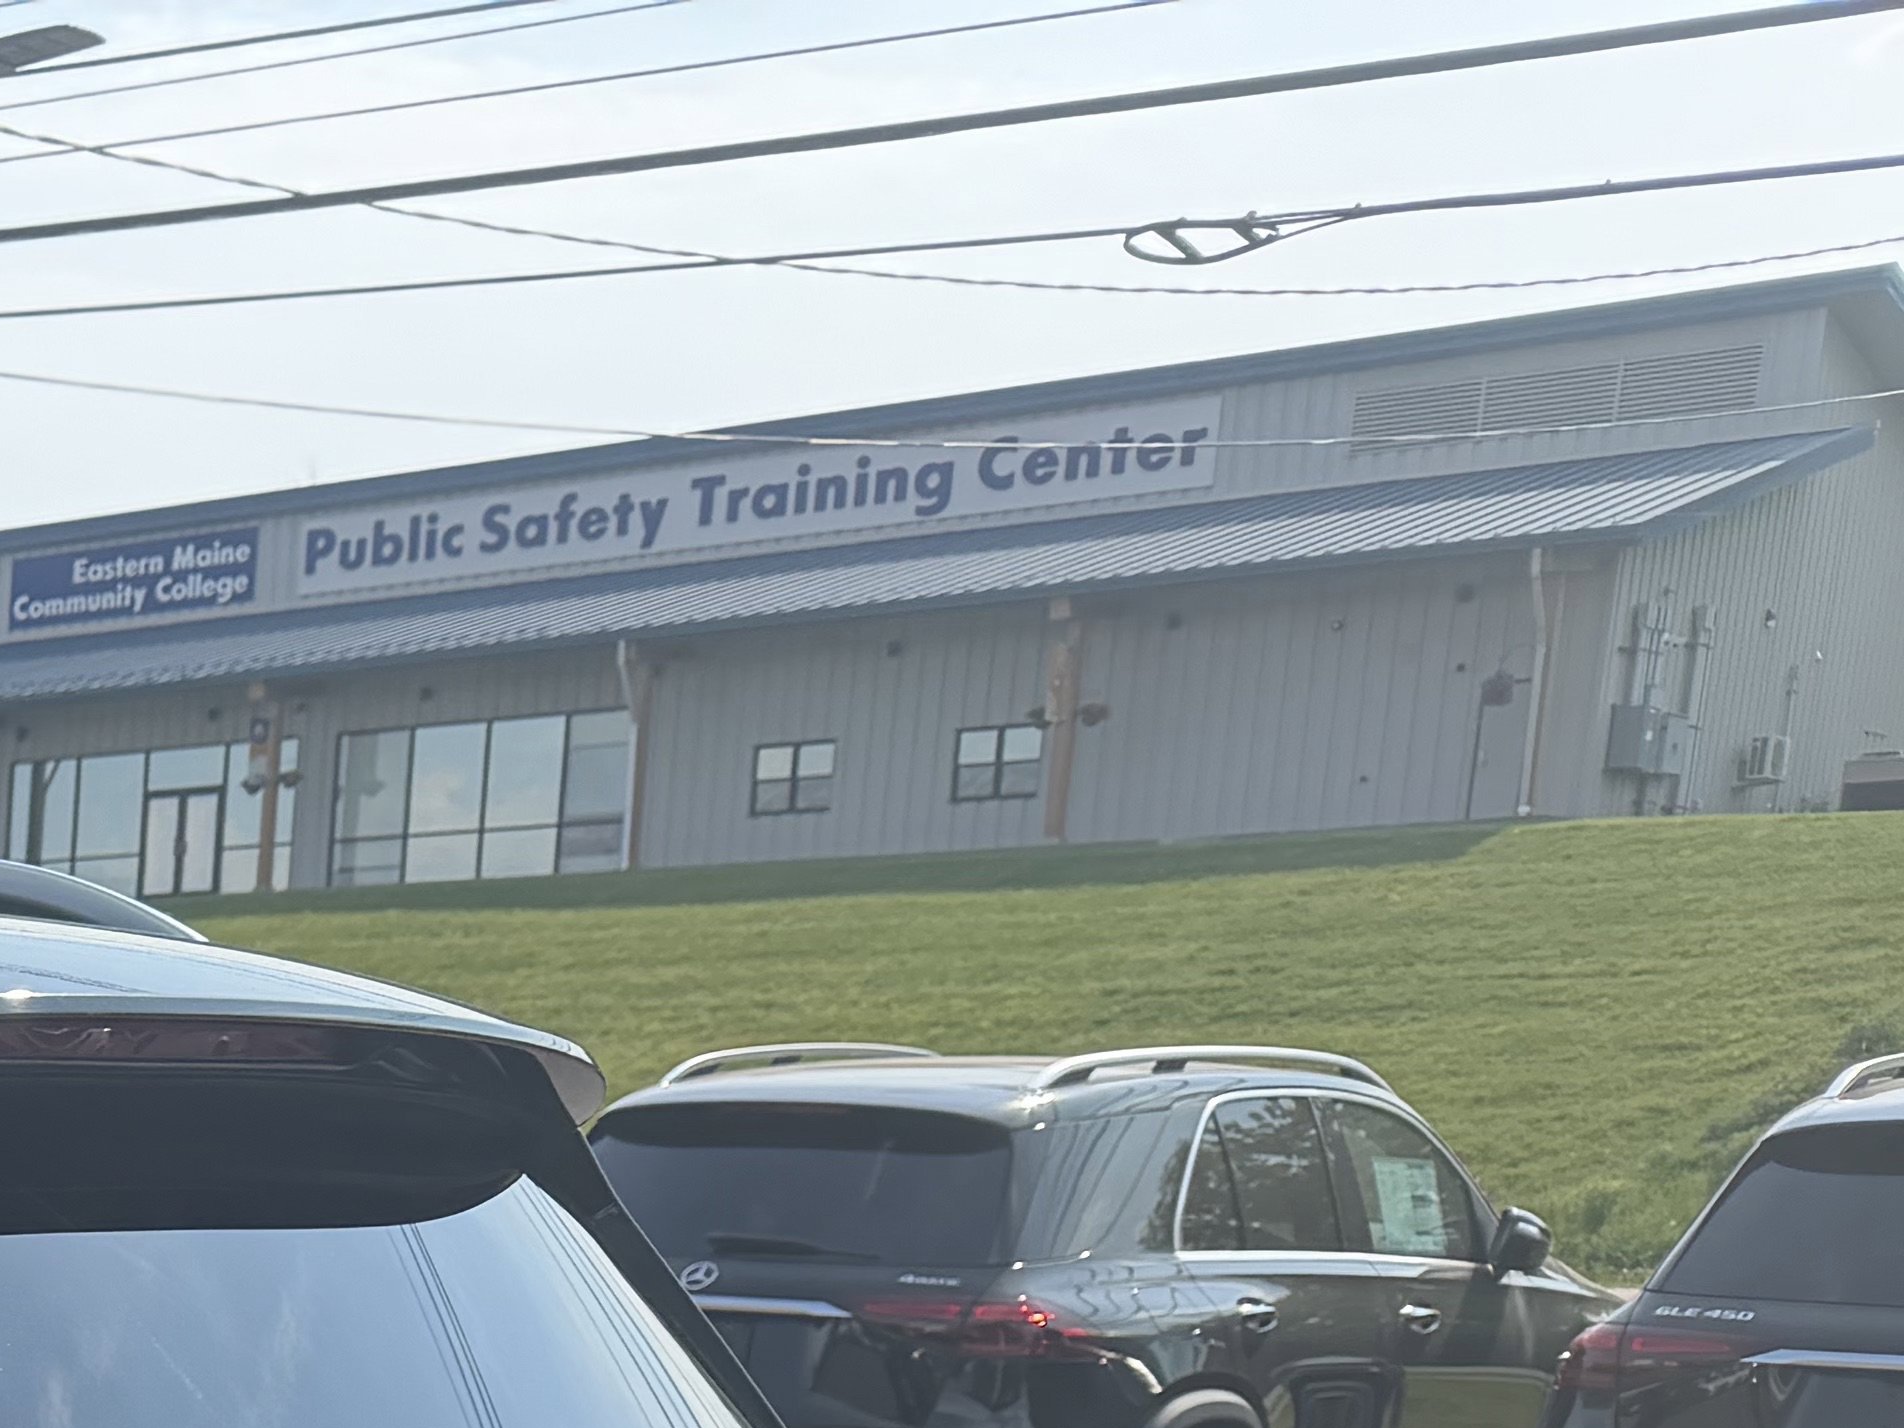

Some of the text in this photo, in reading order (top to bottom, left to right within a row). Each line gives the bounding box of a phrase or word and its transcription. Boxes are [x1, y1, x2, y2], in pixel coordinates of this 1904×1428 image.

[304, 426, 1209, 575] Public Safety Training Center
[72, 539, 251, 584] Eastern Maine
[13, 573, 249, 622] Community College
[1655, 1305, 1756, 1321] GLE 450
